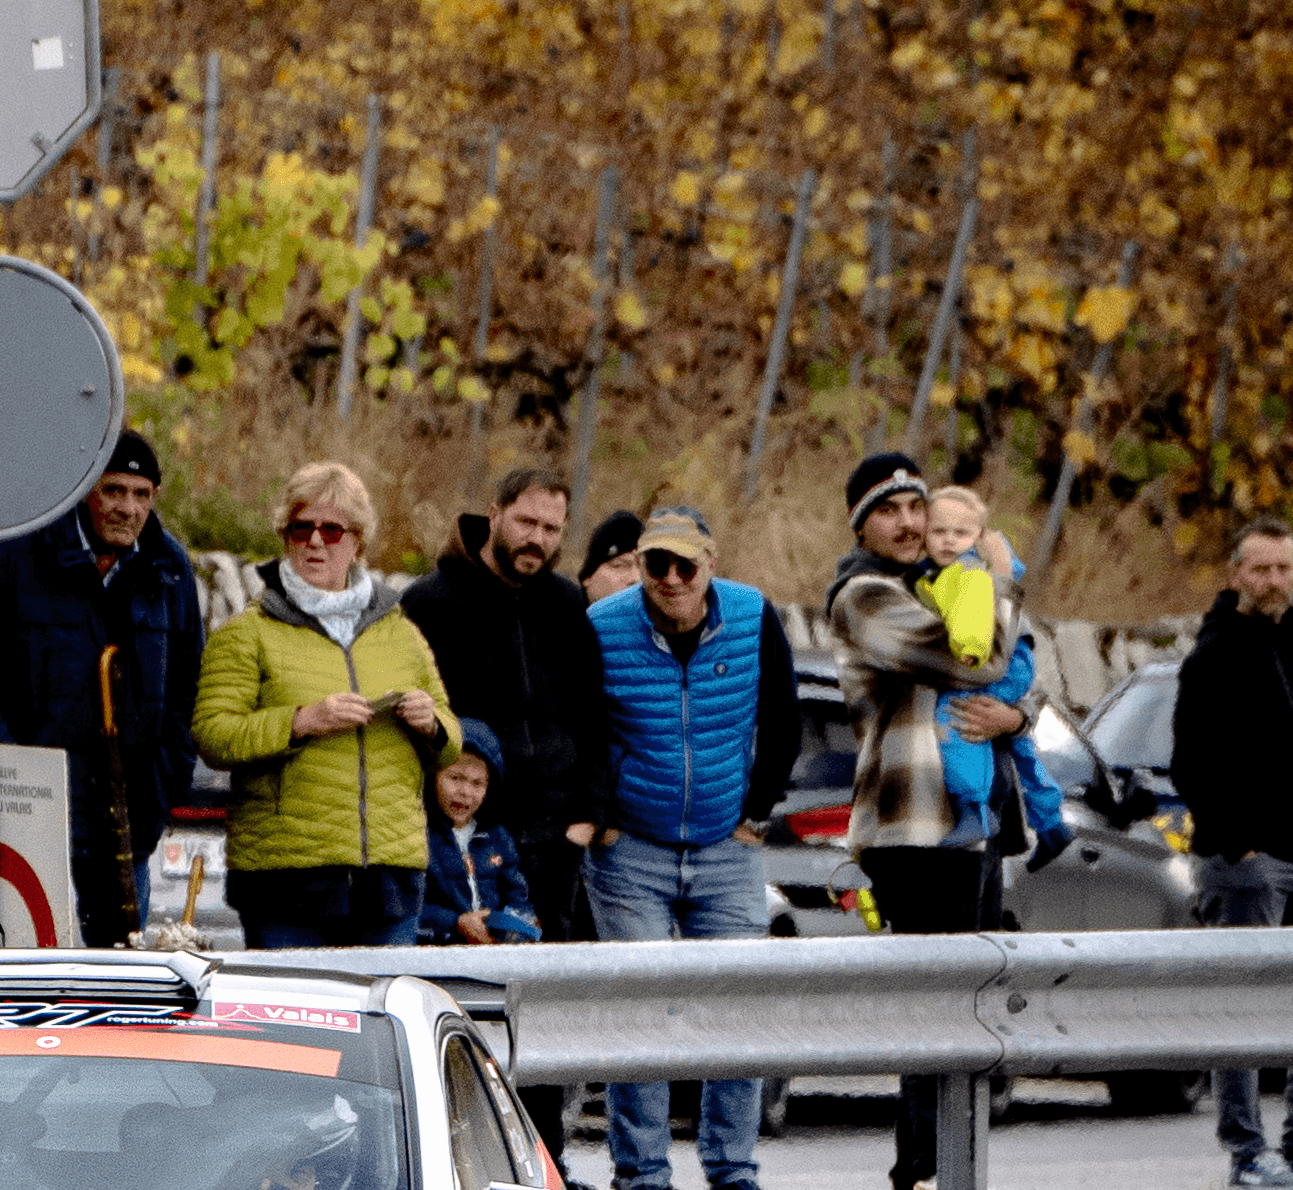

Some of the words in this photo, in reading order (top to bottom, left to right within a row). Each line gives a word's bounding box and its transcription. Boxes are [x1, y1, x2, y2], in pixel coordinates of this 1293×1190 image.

[5, 802, 32, 815] VALAIS
[107, 1016, 218, 1027] rogertuning.com
[263, 1007, 349, 1026] Valais
